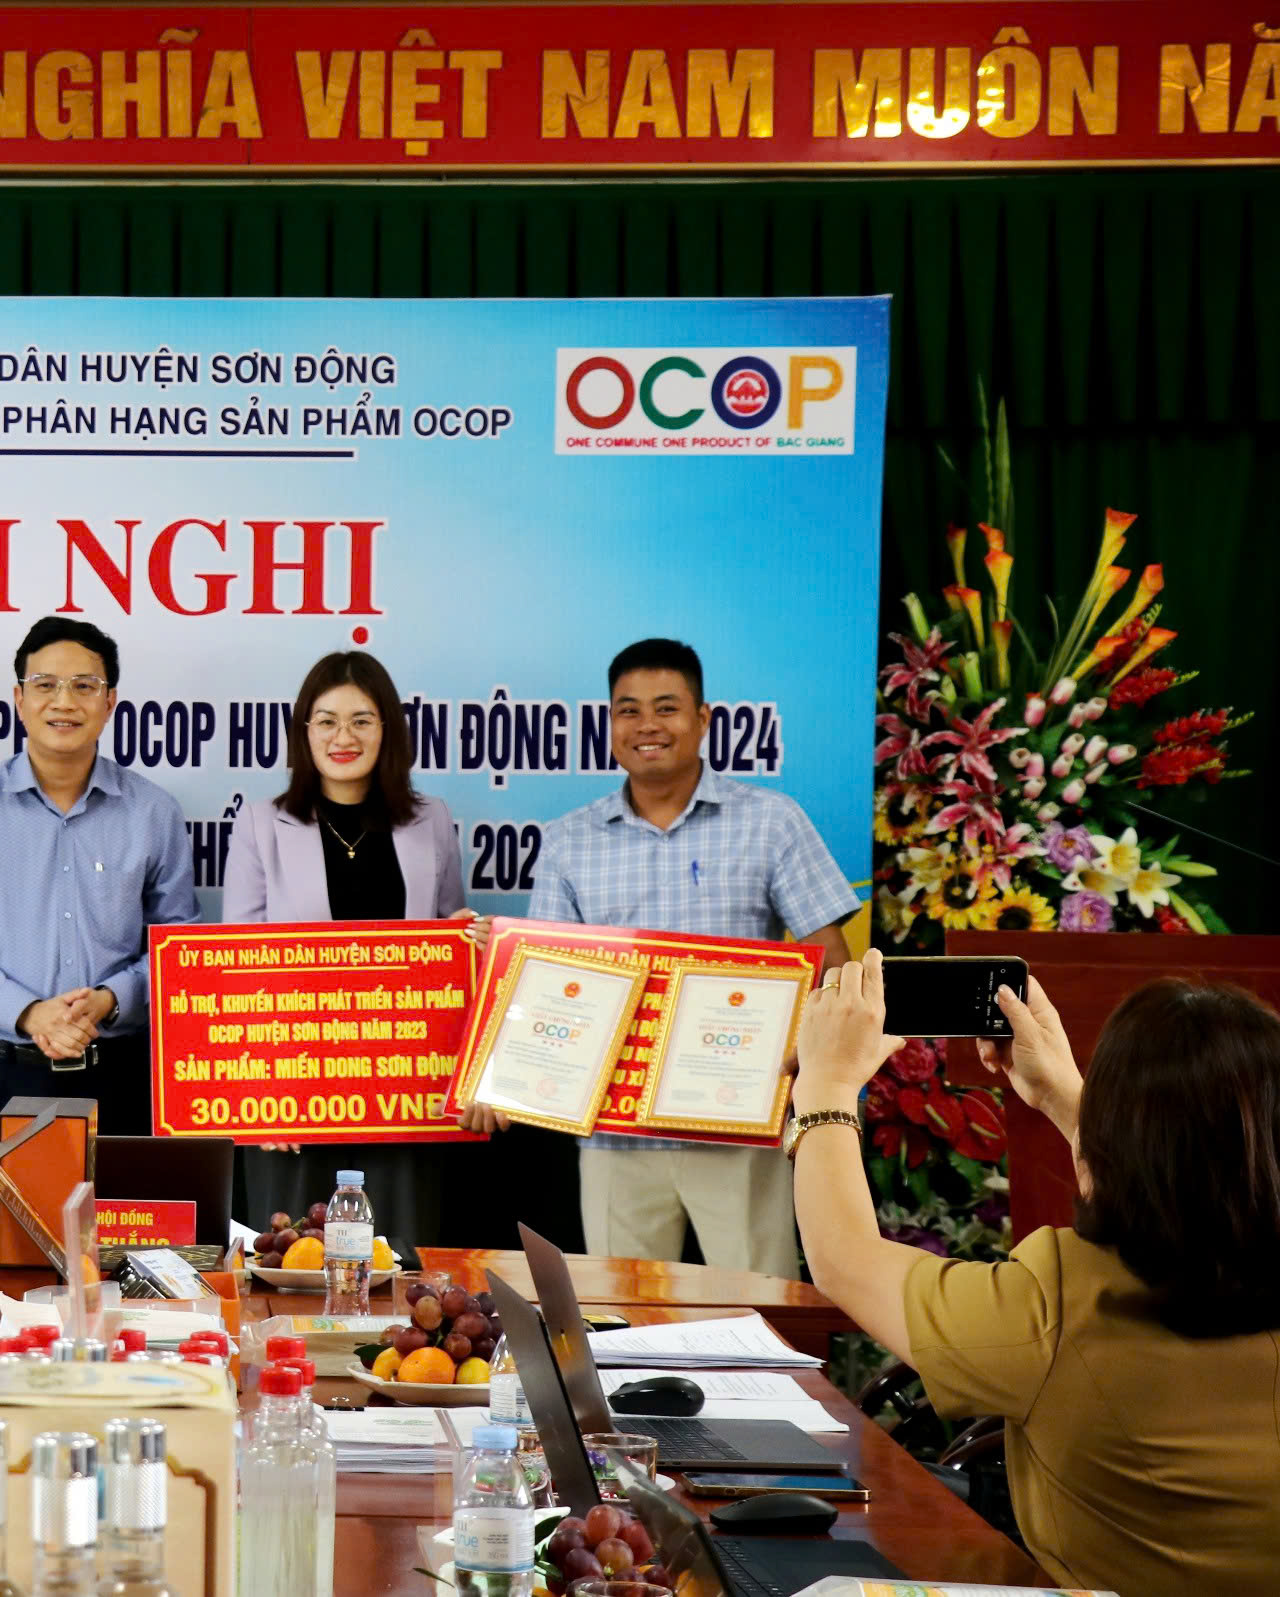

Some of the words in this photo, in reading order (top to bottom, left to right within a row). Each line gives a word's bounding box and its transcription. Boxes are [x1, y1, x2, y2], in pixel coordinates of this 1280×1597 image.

[297, 29, 501, 155] VIỆT
[543, 48, 773, 139] NAM
[813, 26, 1119, 139] MUÔN
[1159, 22, 1280, 133] NĂ
[81, 347, 198, 389] HUYỆN
[211, 350, 281, 384] SƠN
[295, 348, 395, 390] ĐỘNG
[566, 355, 843, 430] OCOP
[3, 399, 96, 435] PHÂN
[110, 406, 207, 441] HẠNG
[220, 396, 292, 436] SẢN
[303, 391, 401, 437] PHẨM
[414, 407, 512, 437] OCOP
[567, 437, 591, 448] ONE
[596, 437, 657, 448] COMMUNE
[663, 437, 687, 448] ONE
[692, 437, 750, 448] PRODUCT
[755, 437, 771, 448] OF
[55, 518, 384, 645] NGHỊ
[114, 700, 216, 768] OCOP
[461, 689, 568, 786] ĐỘNG
[708, 705, 779, 772] 024
[471, 823, 542, 890] 202
[179, 944, 200, 967] ỦY
[203, 949, 235, 967] BAN
[238, 944, 280, 966] NHÂN
[284, 944, 315, 965] DÂN
[319, 942, 370, 967] HUYỆN
[374, 943, 406, 963] SƠN
[409, 941, 453, 965] ĐỘNG
[318, 987, 352, 1011] PHÁT
[395, 984, 423, 1009] SẢN
[209, 1024, 244, 1043] OCOP
[246, 1019, 290, 1046] HUYỆN
[292, 1021, 320, 1042] SƠN
[361, 1017, 392, 1040] NĂM
[395, 1020, 428, 1040] 2023
[174, 1053, 211, 1081] SẢN
[324, 1056, 373, 1079] DONG
[376, 1054, 413, 1078] SƠN
[416, 1050, 458, 1081] ĐỘN
[191, 1095, 366, 1125] 30.000.000
[96, 1209, 117, 1228] HỘI
